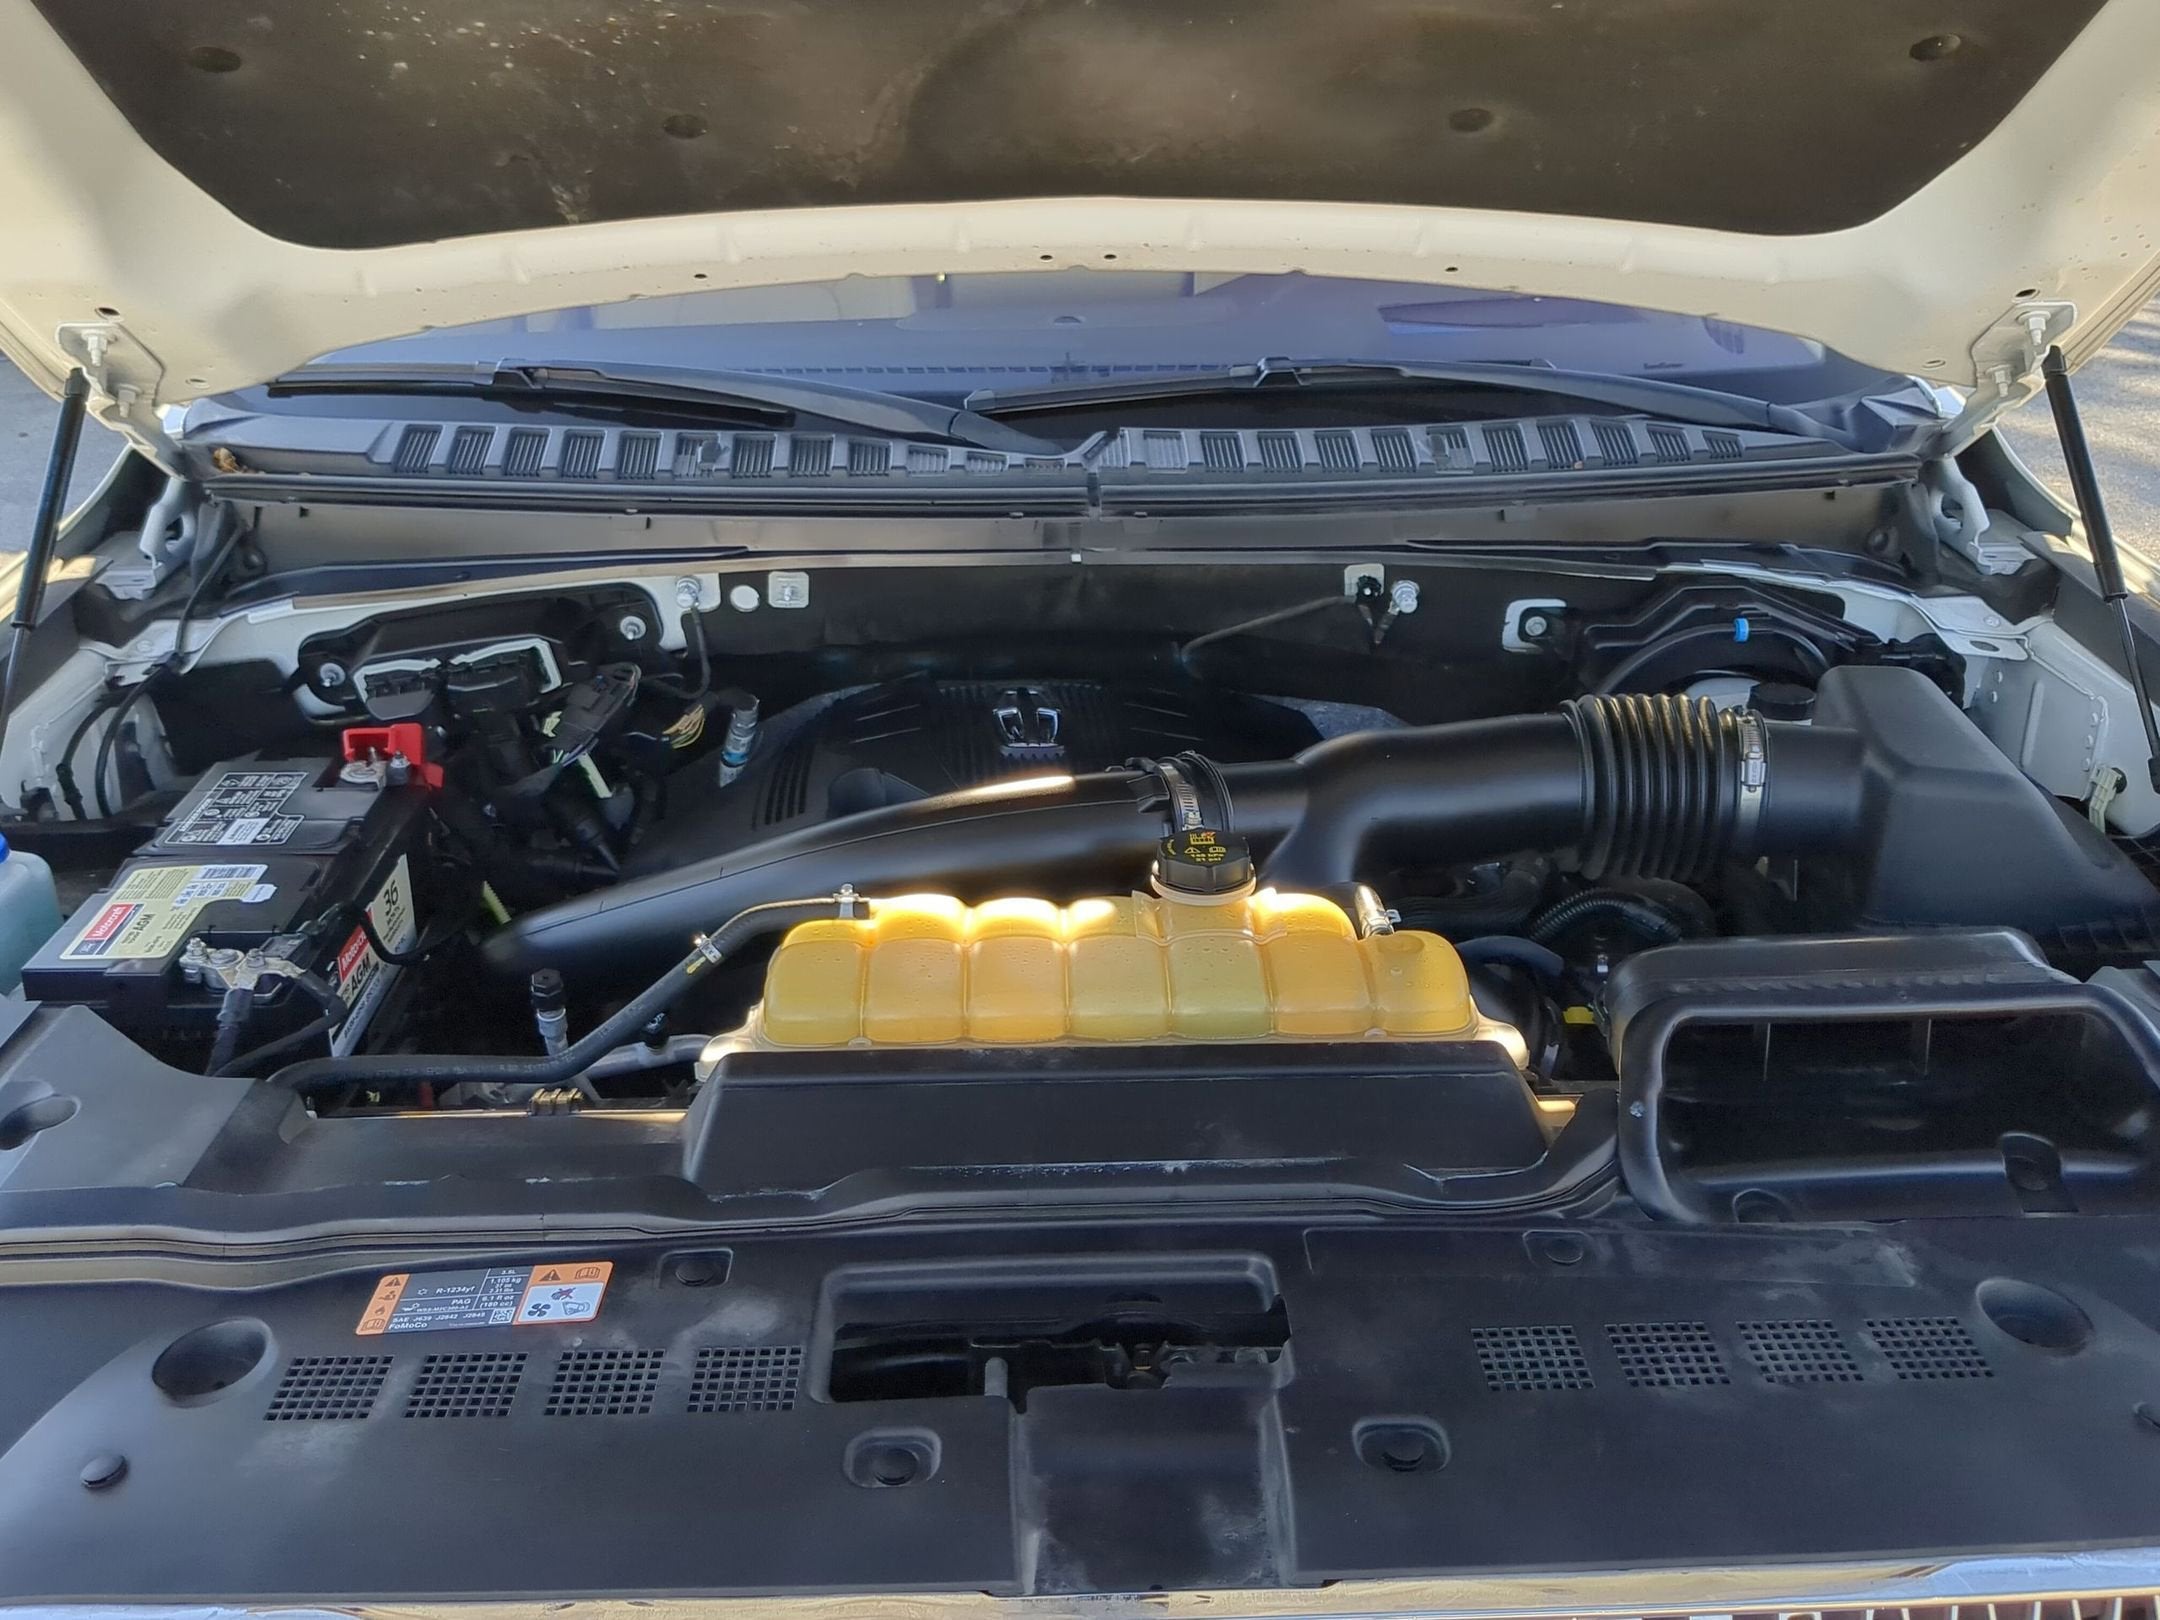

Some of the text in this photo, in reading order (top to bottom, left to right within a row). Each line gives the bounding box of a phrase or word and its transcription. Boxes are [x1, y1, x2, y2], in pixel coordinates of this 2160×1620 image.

[384, 880, 399, 916] 36
[92, 906, 128, 937] Motorcraft
[133, 913, 156, 931] AGM
[351, 952, 371, 996] AGM
[435, 1285, 476, 1294] R-1234yf
[388, 1322, 428, 1330] FoMoCo
